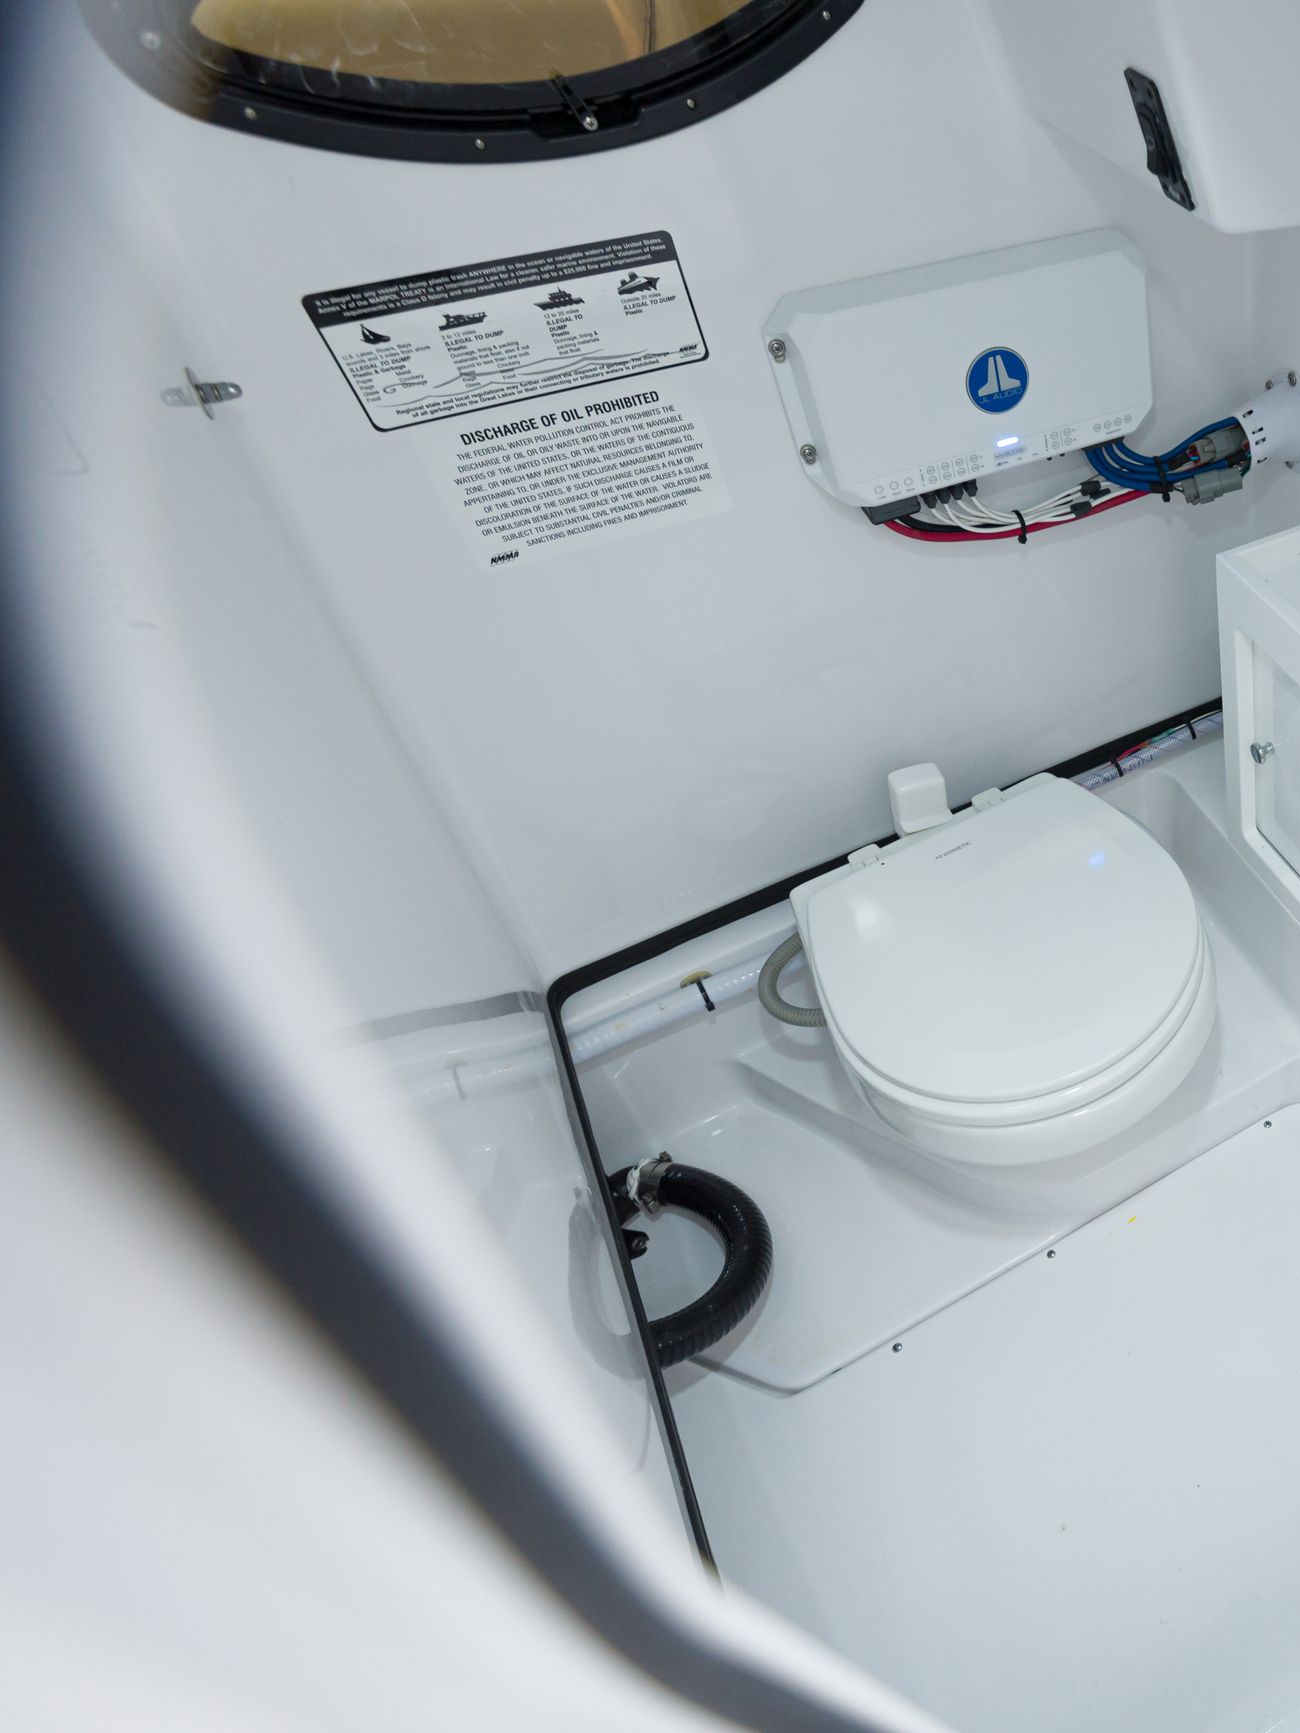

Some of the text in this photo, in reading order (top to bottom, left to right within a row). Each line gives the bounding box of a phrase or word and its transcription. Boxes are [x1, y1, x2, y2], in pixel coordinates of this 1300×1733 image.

[469, 266, 507, 278] ANYWHERE
[460, 390, 660, 446] DISCHARGE OF OIL PROHIBITED
[993, 387, 1022, 400] AUDIO
[454, 473, 486, 486] WATERS
[487, 470, 498, 478] OF
[499, 466, 514, 475] THE
[515, 459, 541, 472] UNITED
[571, 450, 582, 458] OR
[583, 446, 597, 455] THE
[598, 439, 626, 452] WATERS
[627, 437, 636, 445] OF
[638, 433, 651, 442] THE
[652, 422, 695, 439] CONTIGUOUS
[458, 404, 675, 461] THE FEDERAL WATER POLLUTION CONTROL ACT PROHIBITS THE
[458, 414, 683, 473] DISCHARGE OF OIL OR OILY WASTE INTO OR UPON THE NAVIGABLE
[463, 489, 516, 507] APPERTAINING
[530, 482, 541, 491] OR
[542, 476, 567, 488] UNDER
[568, 472, 582, 481] THE
[583, 463, 619, 478] EXCLUSIVE
[620, 451, 667, 469] MANAGEMENT
[668, 442, 704, 457] AUTHORITY
[484, 505, 495, 514] OF
[496, 501, 510, 511] THE
[511, 495, 537, 507] UNITED
[574, 480, 594, 491] SUCH
[595, 471, 633, 486] DISCHARGE
[635, 464, 661, 476] CAUSES
[668, 458, 684, 467] FILM
[685, 455, 695, 463] OR
[488, 481, 500, 490] OR
[501, 475, 526, 487] WHICH
[527, 471, 543, 480] MAY
[544, 464, 570, 476] AFFECT
[571, 456, 602, 470] NATURAL
[603, 446, 644, 462] RESOURCES
[646, 437, 682, 452] BELONGING
[476, 507, 532, 527] DISCOLORATION
[533, 504, 543, 512] OF
[544, 501, 558, 509] THE
[559, 493, 590, 506] SURFACE
[591, 490, 600, 498] OF
[602, 486, 615, 495] THE
[616, 480, 639, 492] WATER
[640, 477, 650, 486] OR
[651, 470, 677, 483] CAUSES
[684, 462, 710, 474] SLUDGE
[482, 528, 494, 537] OR
[494, 518, 532, 534] EMULSION
[532, 510, 564, 524] BENEATH
[565, 506, 578, 516] THE
[579, 498, 610, 512] SURFACE
[611, 496, 620, 504] OF
[622, 492, 634, 501] THE
[663, 476, 698, 491] VIOLATORS
[699, 472, 713, 481] ARE
[502, 485, 703, 543] SUBJECT TO SUBSTANTIAL CIVIL PENALTIES AND/OR CRIMINAL
[490, 550, 519, 565] NMMA
[527, 531, 566, 547] SANCTIONS
[567, 521, 603, 536] INCLUDING
[604, 516, 623, 527] FINES
[624, 512, 638, 521] AND
[943, 840, 971, 856] DOMETIC
